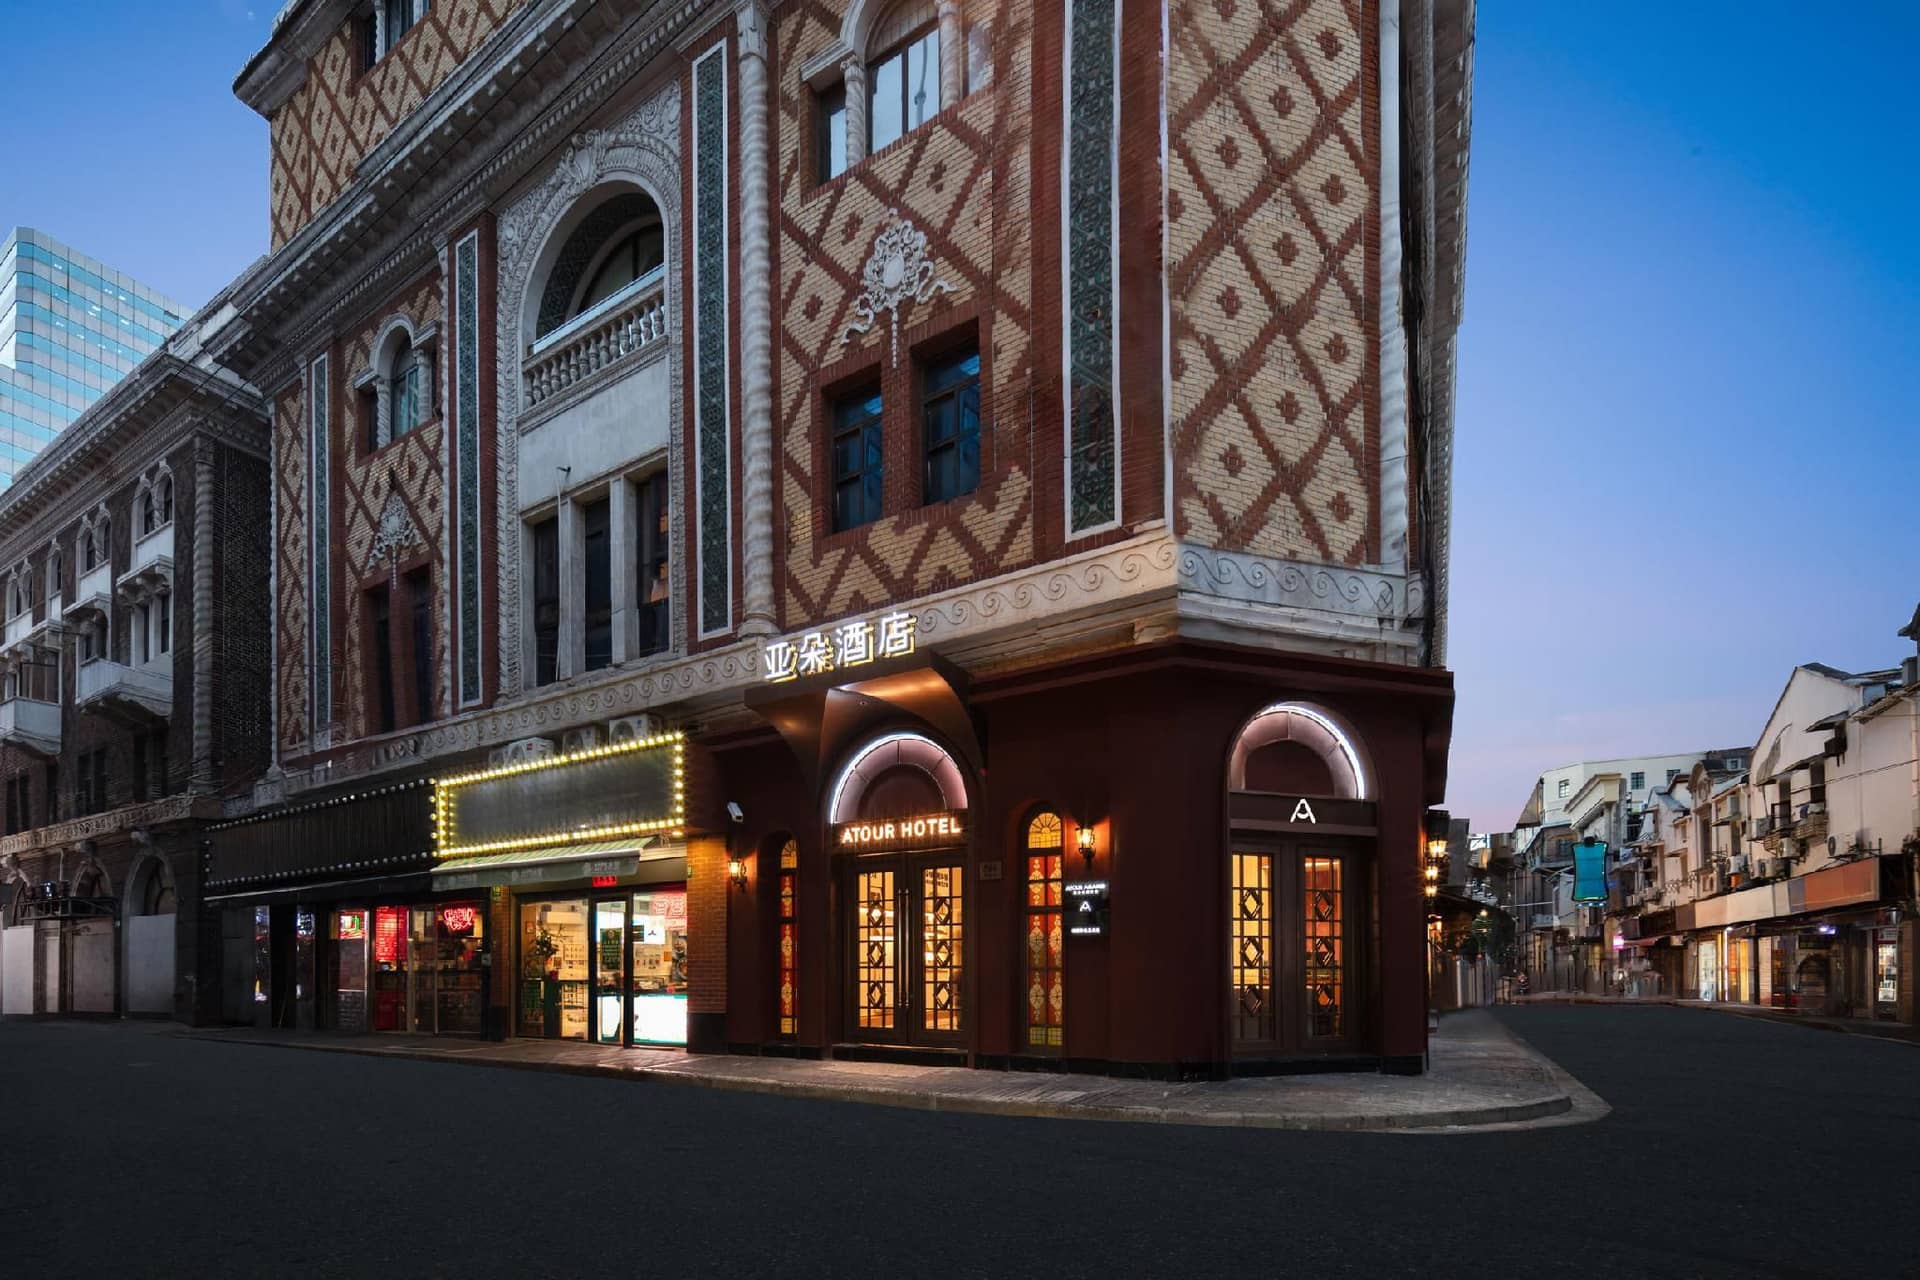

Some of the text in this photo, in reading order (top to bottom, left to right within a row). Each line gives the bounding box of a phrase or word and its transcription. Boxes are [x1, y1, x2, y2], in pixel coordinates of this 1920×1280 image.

[764, 611, 916, 682] 亚朵酒店
[841, 817, 961, 844] ATOUR HOTEL
